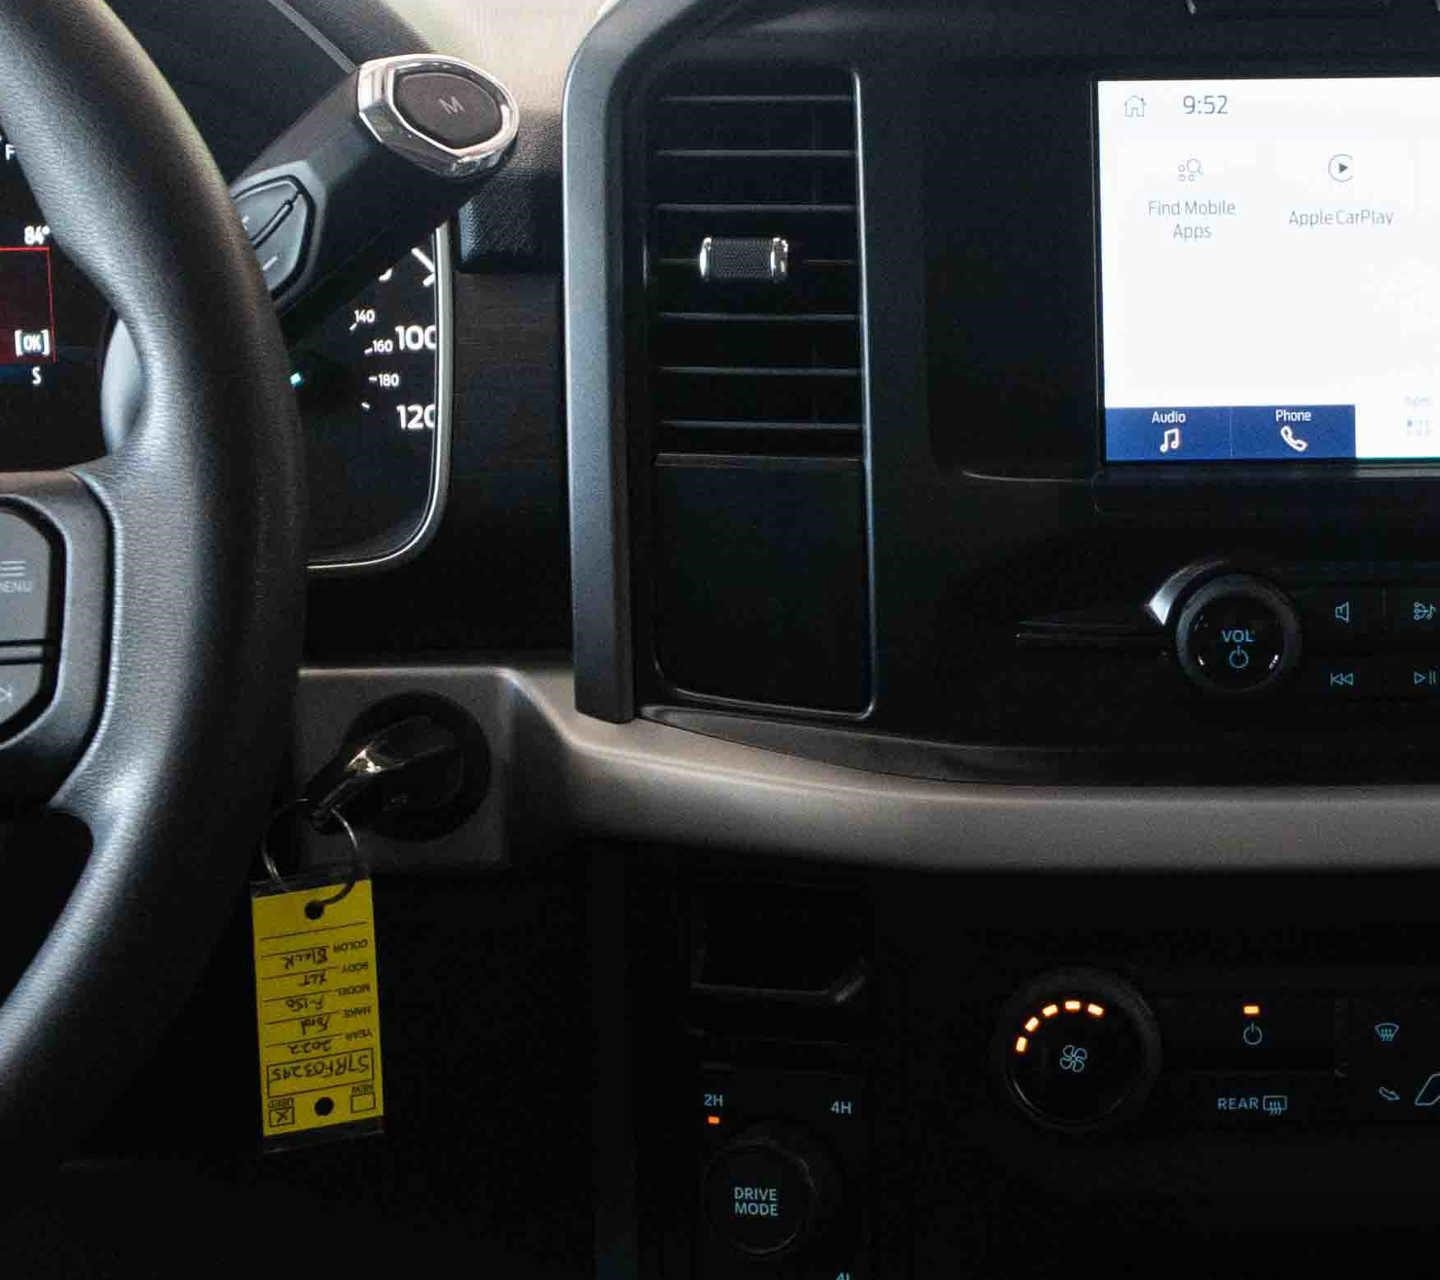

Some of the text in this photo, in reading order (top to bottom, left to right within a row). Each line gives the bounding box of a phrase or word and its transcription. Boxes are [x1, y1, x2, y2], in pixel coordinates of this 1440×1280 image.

[439, 96, 466, 116] M
[1182, 95, 1229, 116] 9:52
[5, 145, 16, 161] F
[1147, 199, 1237, 217] Find Mobile
[1288, 209, 1394, 228] Apple CarPlay
[1172, 222, 1213, 242] Apps
[354, 309, 376, 324] 140
[372, 339, 394, 353] 160
[32, 368, 42, 386] S
[378, 373, 400, 387] 180
[1151, 409, 1187, 425] Audio
[1274, 407, 1313, 424] Phone
[1221, 629, 1255, 644] VOL
[288, 1040, 333, 1055] 2022
[703, 1094, 723, 1108] 2H
[830, 1101, 853, 1115] 4H
[1217, 1096, 1260, 1111] REAR
[733, 1186, 778, 1202] DRIVE
[733, 1202, 779, 1217] MODE
